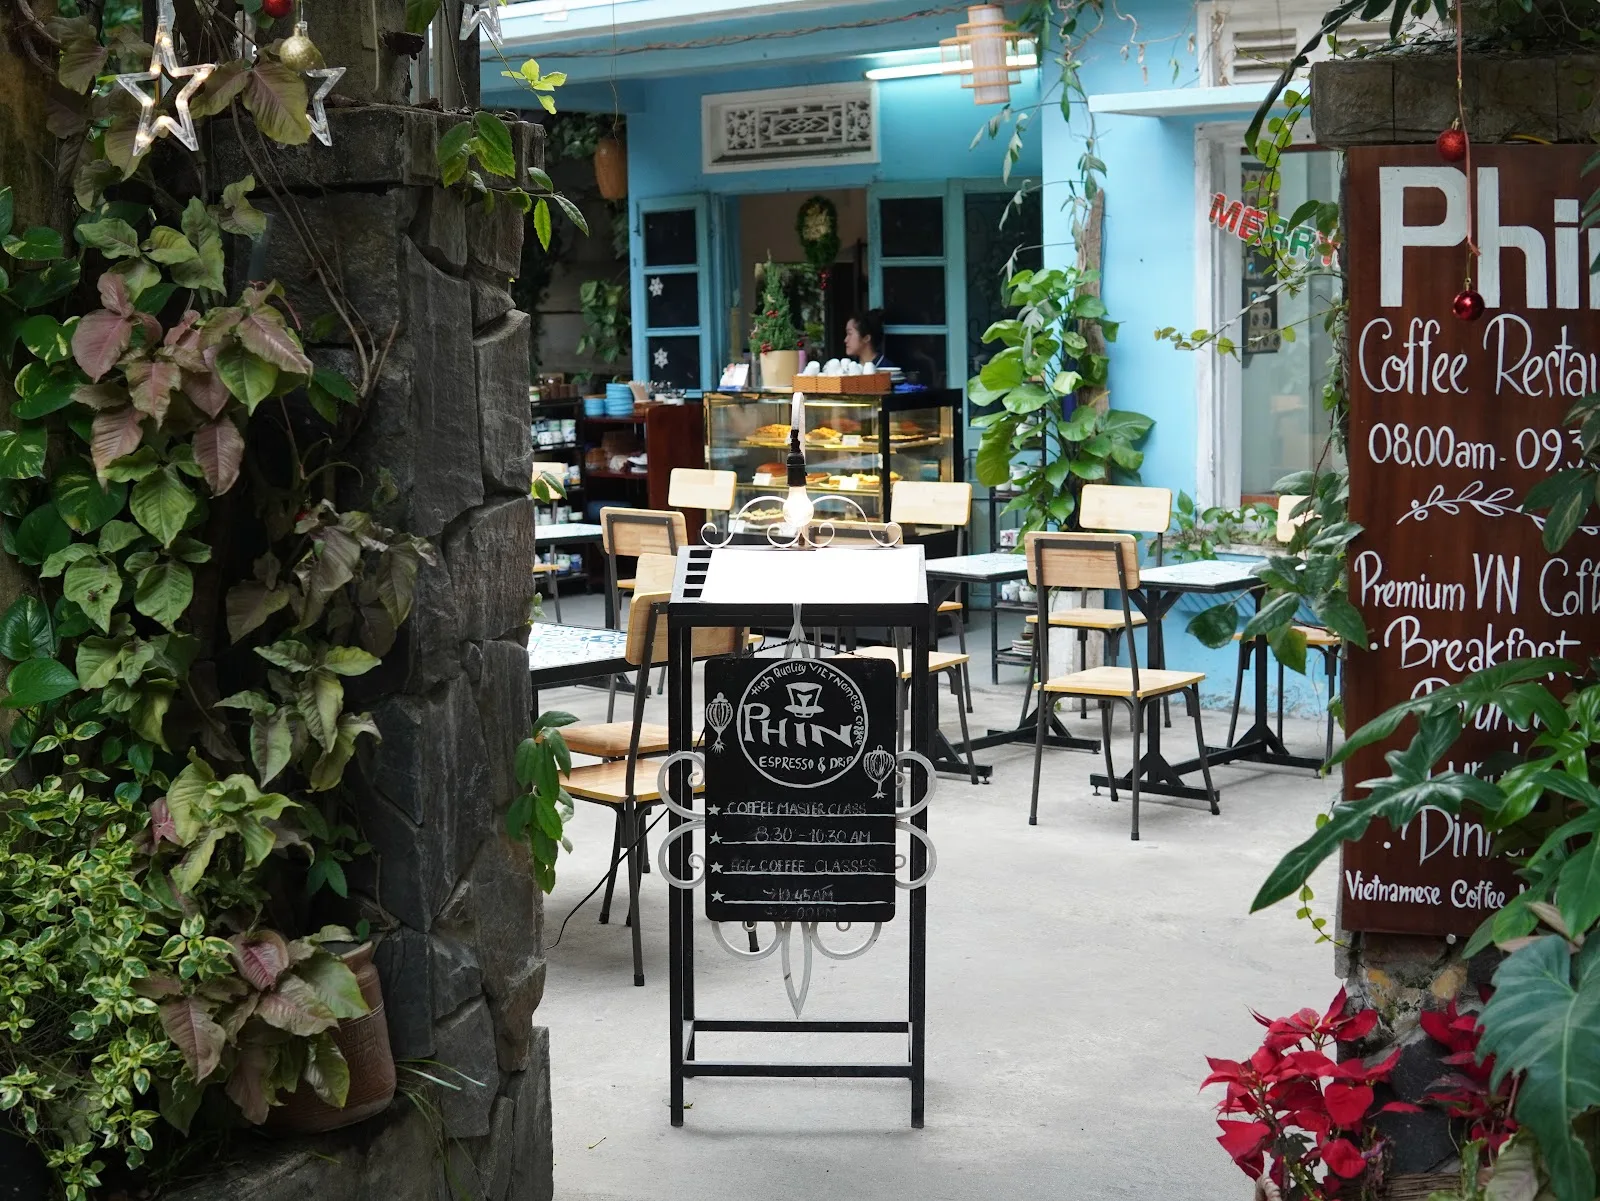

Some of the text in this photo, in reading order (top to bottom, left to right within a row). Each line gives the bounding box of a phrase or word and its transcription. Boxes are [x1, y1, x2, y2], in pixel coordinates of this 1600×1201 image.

[1379, 166, 1600, 310] Phi
[1358, 316, 1469, 395] Coffee
[1368, 422, 1495, 471] 08.00am
[1515, 428, 1600, 472] 09.3
[1354, 550, 1600, 617] Premium VN Coff
[750, 675, 776, 696] High
[773, 662, 807, 678] Quality
[743, 702, 853, 748] PHIN
[758, 755, 815, 771] ESPRESSO
[817, 756, 827, 775] &
[726, 801, 773, 815] COFFEE
[850, 831, 871, 844] AM
[758, 859, 805, 873] COFFEE
[814, 859, 877, 873] CLASSES
[1345, 870, 1443, 906] Vietnamese
[1450, 879, 1506, 910] Coffee
